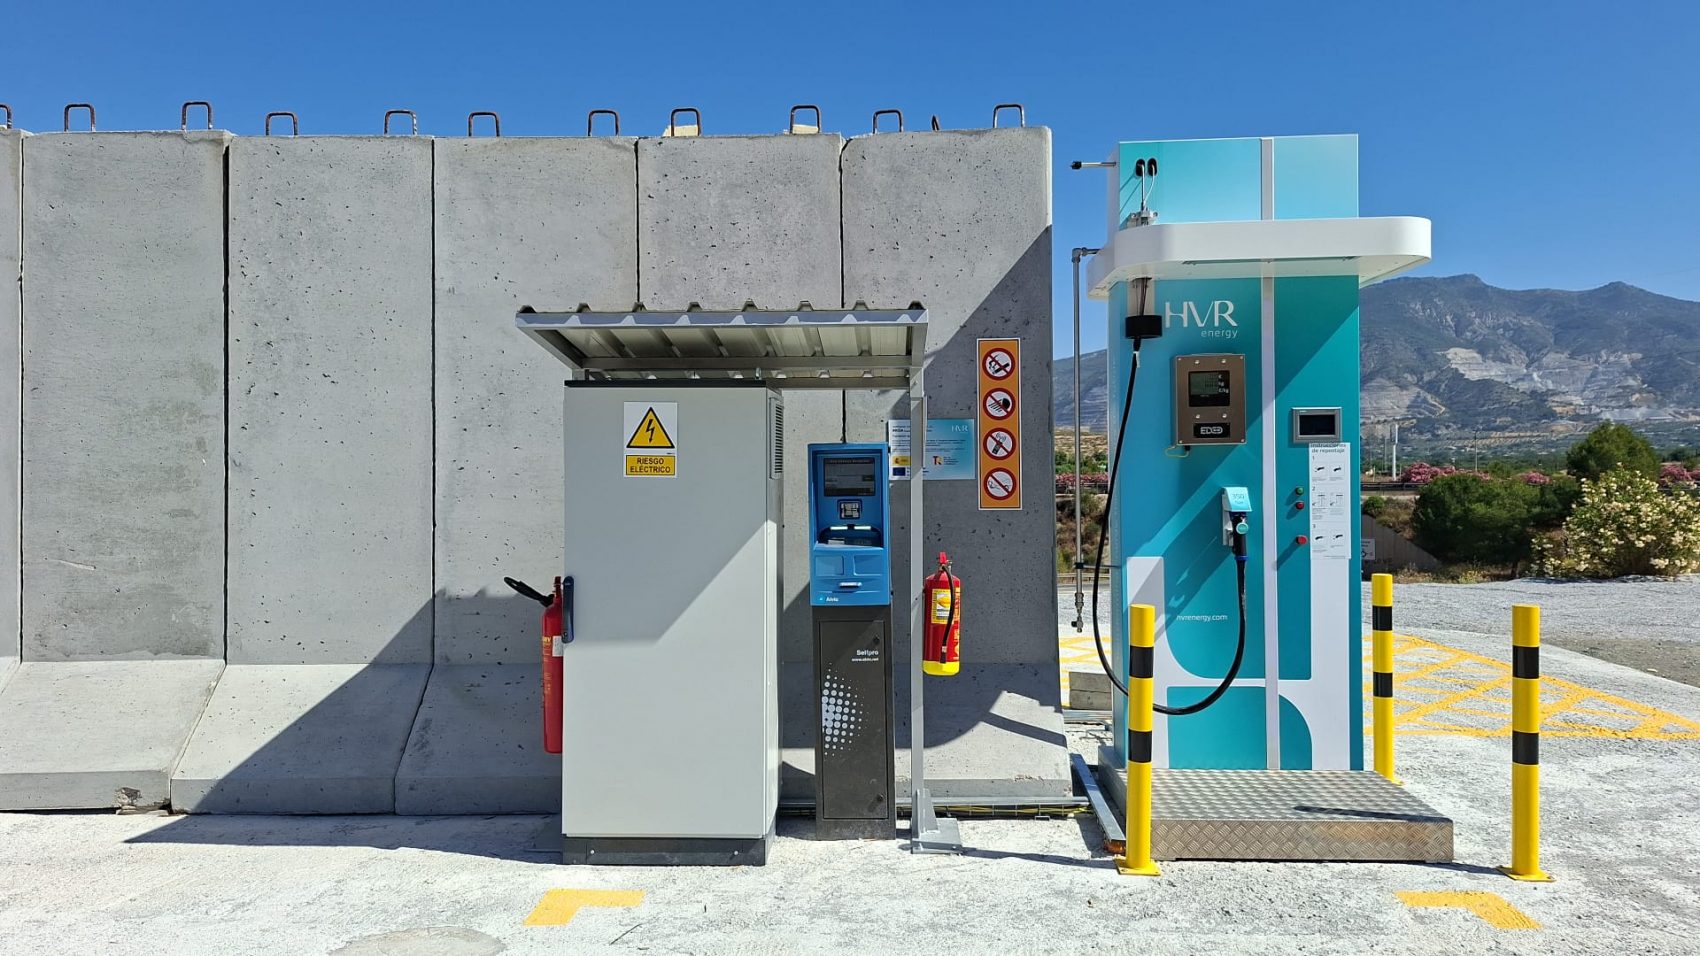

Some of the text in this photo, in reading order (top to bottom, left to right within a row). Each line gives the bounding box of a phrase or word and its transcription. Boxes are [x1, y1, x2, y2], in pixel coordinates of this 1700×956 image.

[1165, 300, 1238, 328] HVR
[1201, 328, 1238, 339] energy
[636, 457, 665, 465] RIESGO
